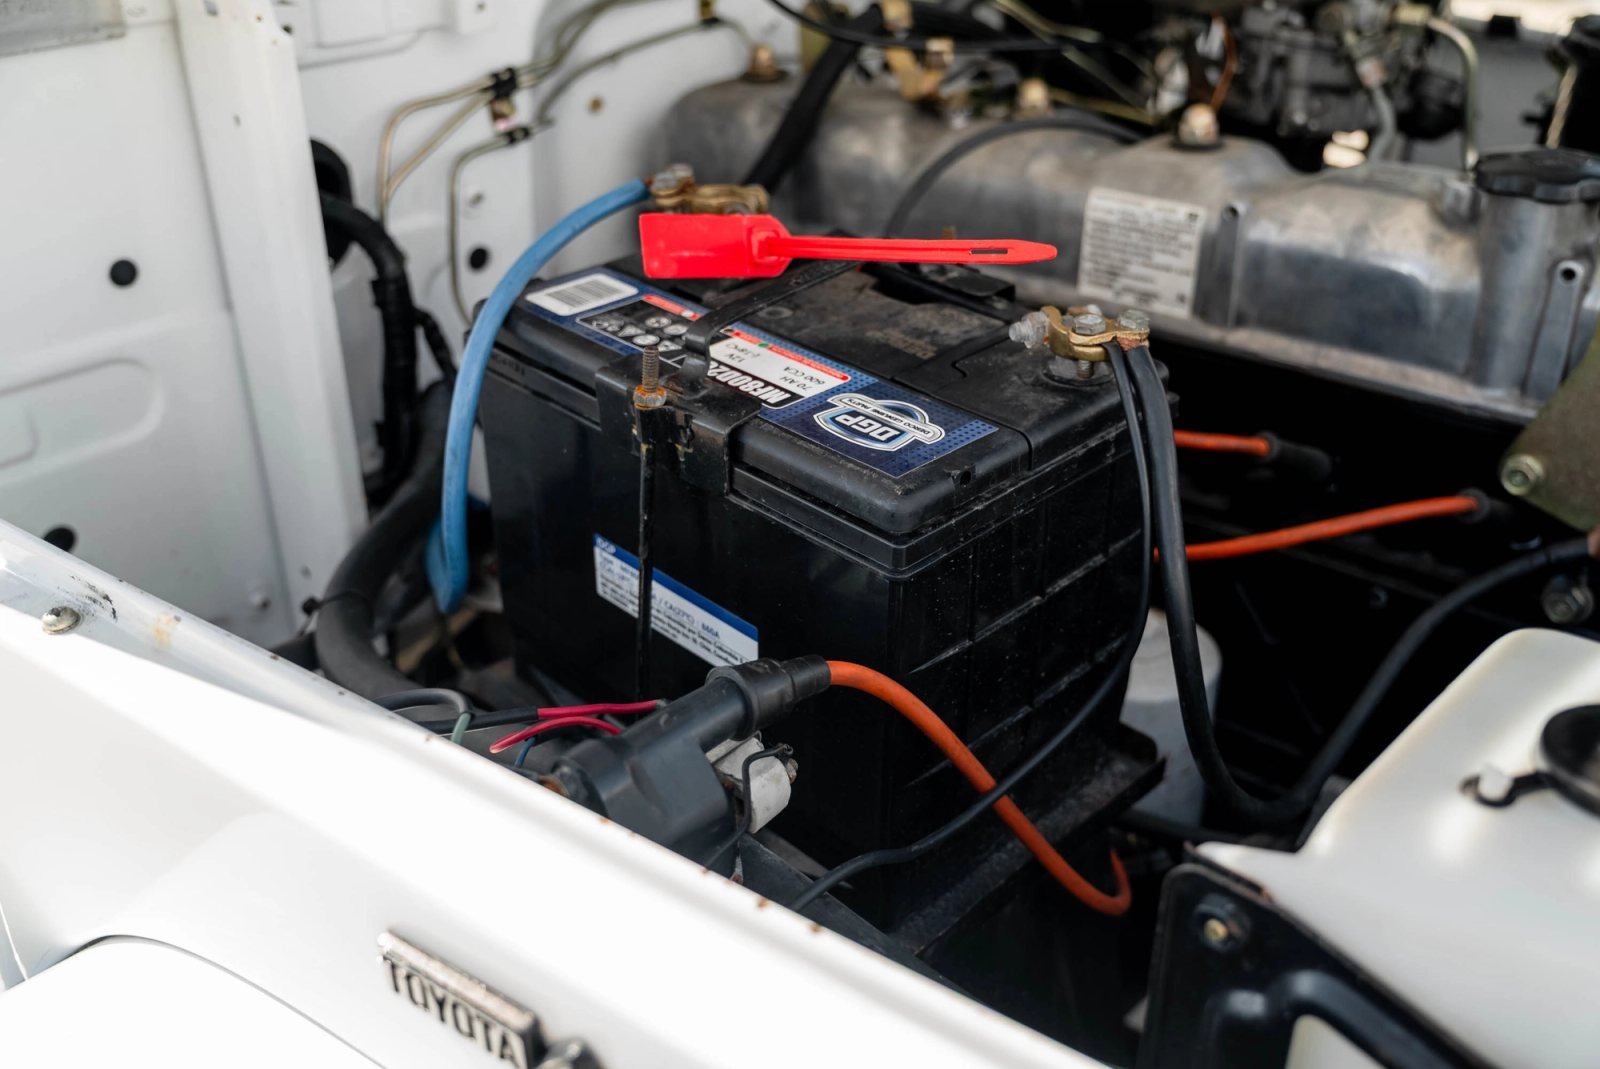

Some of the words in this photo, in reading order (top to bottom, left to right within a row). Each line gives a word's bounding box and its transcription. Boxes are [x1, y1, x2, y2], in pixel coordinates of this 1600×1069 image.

[724, 353, 745, 363] 12V
[783, 366, 805, 378] CCA
[804, 372, 826, 385] 600
[779, 376, 798, 386] AH
[796, 382, 813, 391] 70
[847, 398, 872, 411] PARTS
[871, 407, 903, 426] GENUINE
[835, 412, 900, 441] DGP
[904, 421, 931, 436] DERCO
[383, 956, 523, 1069] TOYOTA
